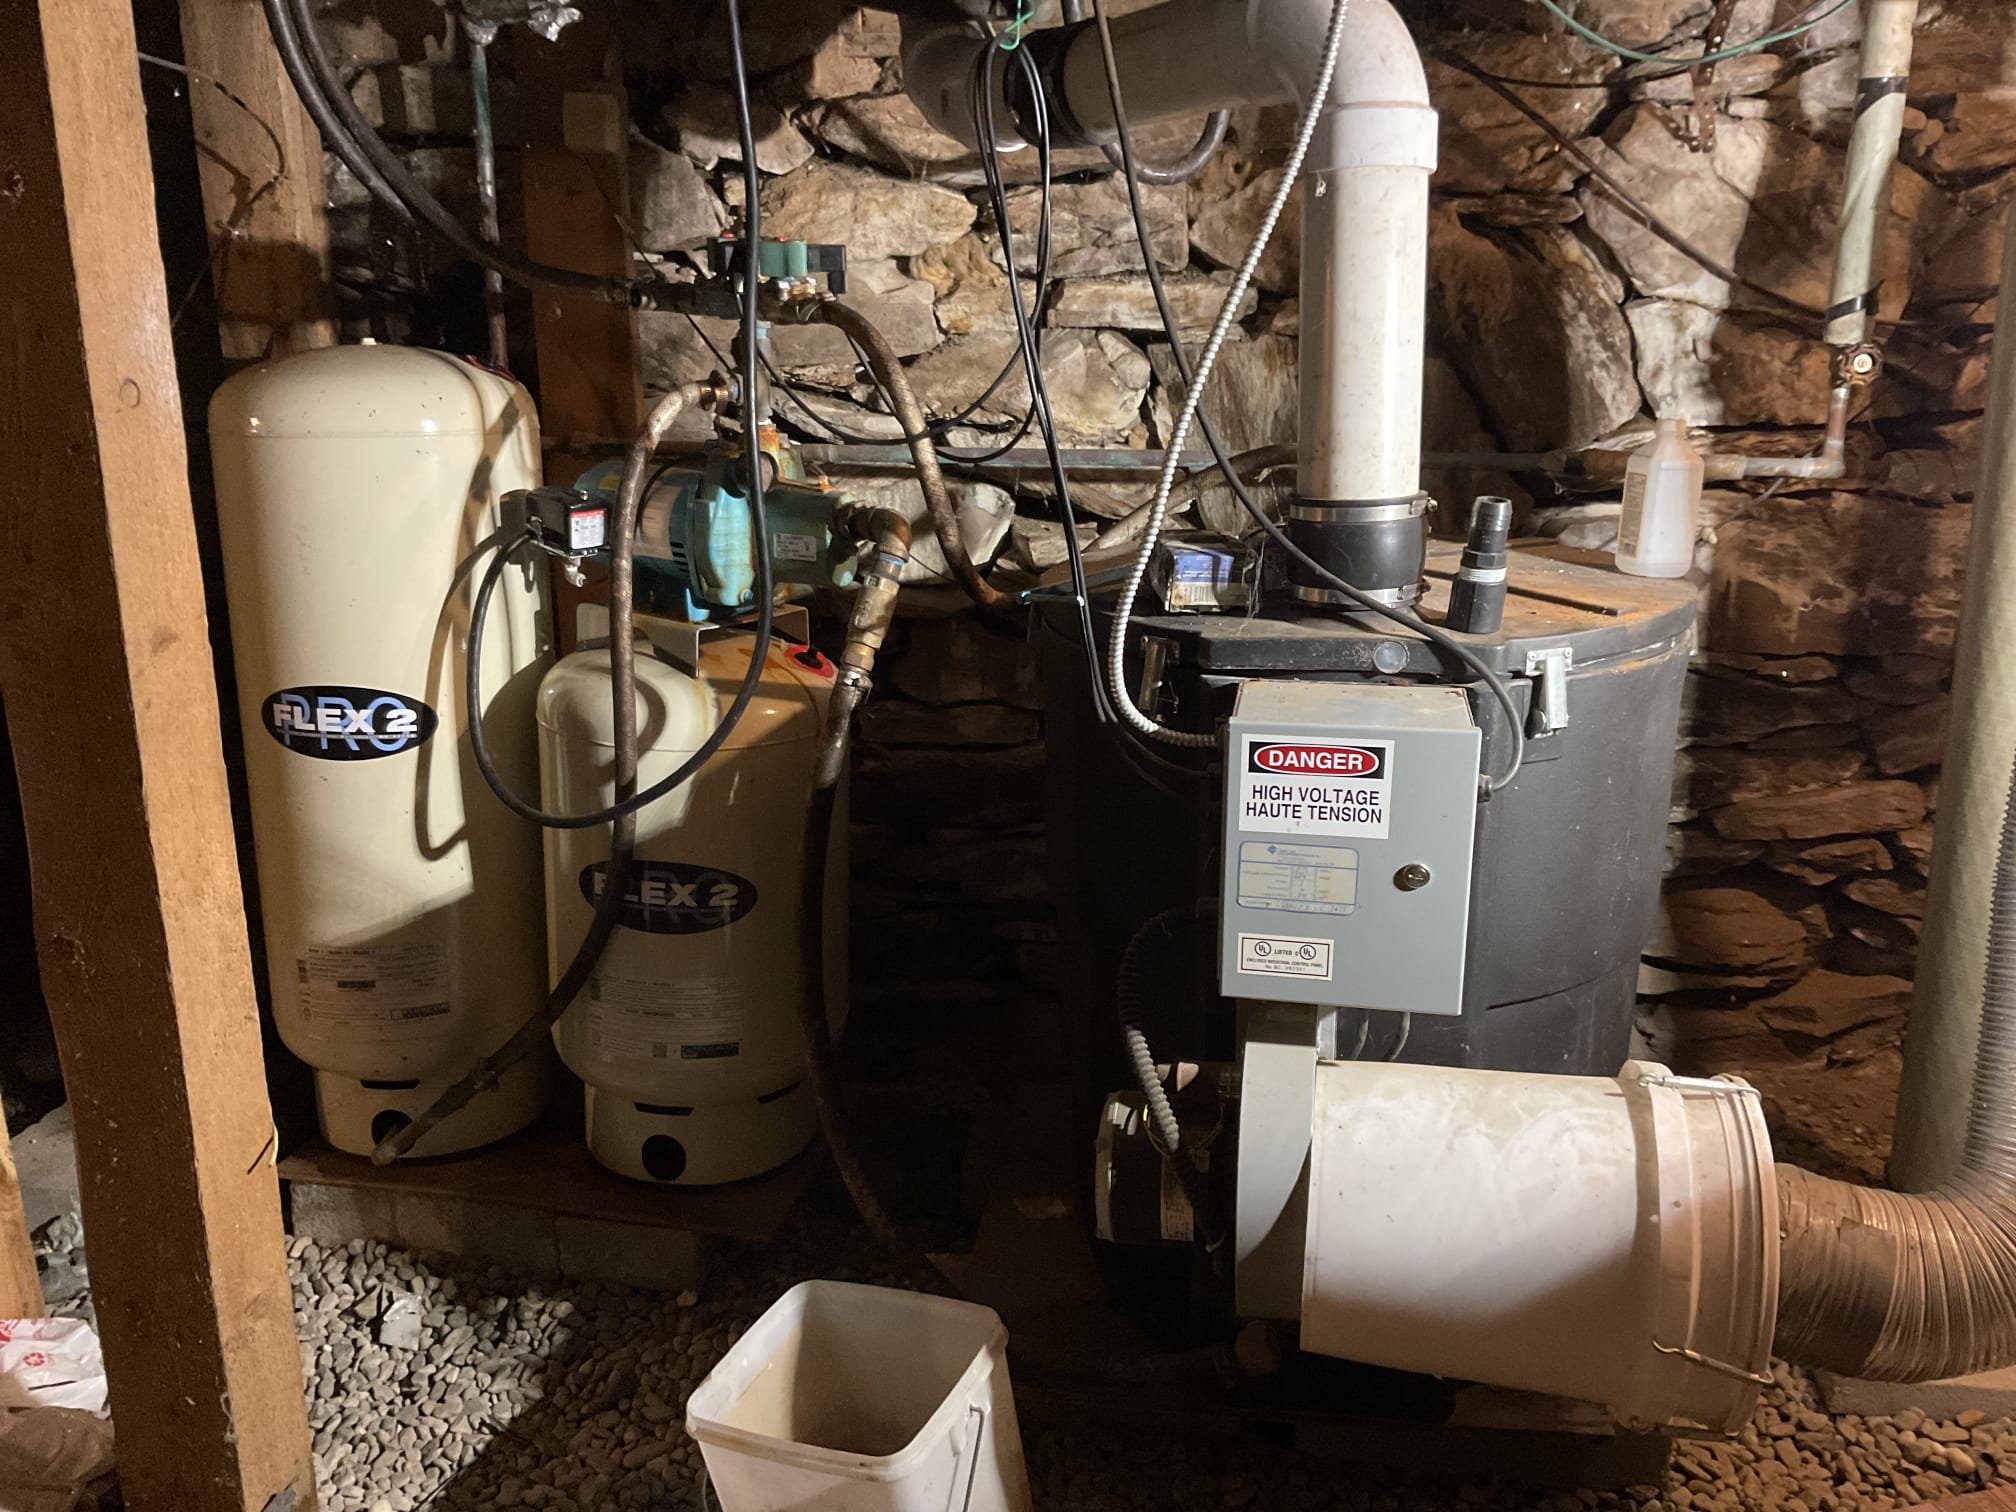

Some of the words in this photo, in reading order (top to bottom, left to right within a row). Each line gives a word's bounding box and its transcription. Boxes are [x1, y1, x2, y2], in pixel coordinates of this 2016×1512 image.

[273, 703, 376, 733] FLEX
[386, 708, 417, 732] 2
[1268, 750, 1363, 771] DANGER
[1252, 784, 1293, 801] HIGH
[1298, 786, 1379, 806] VOLTAGE
[1246, 801, 1302, 819] HAUTE
[1307, 804, 1382, 824] TENSION
[708, 883, 739, 907] 2
